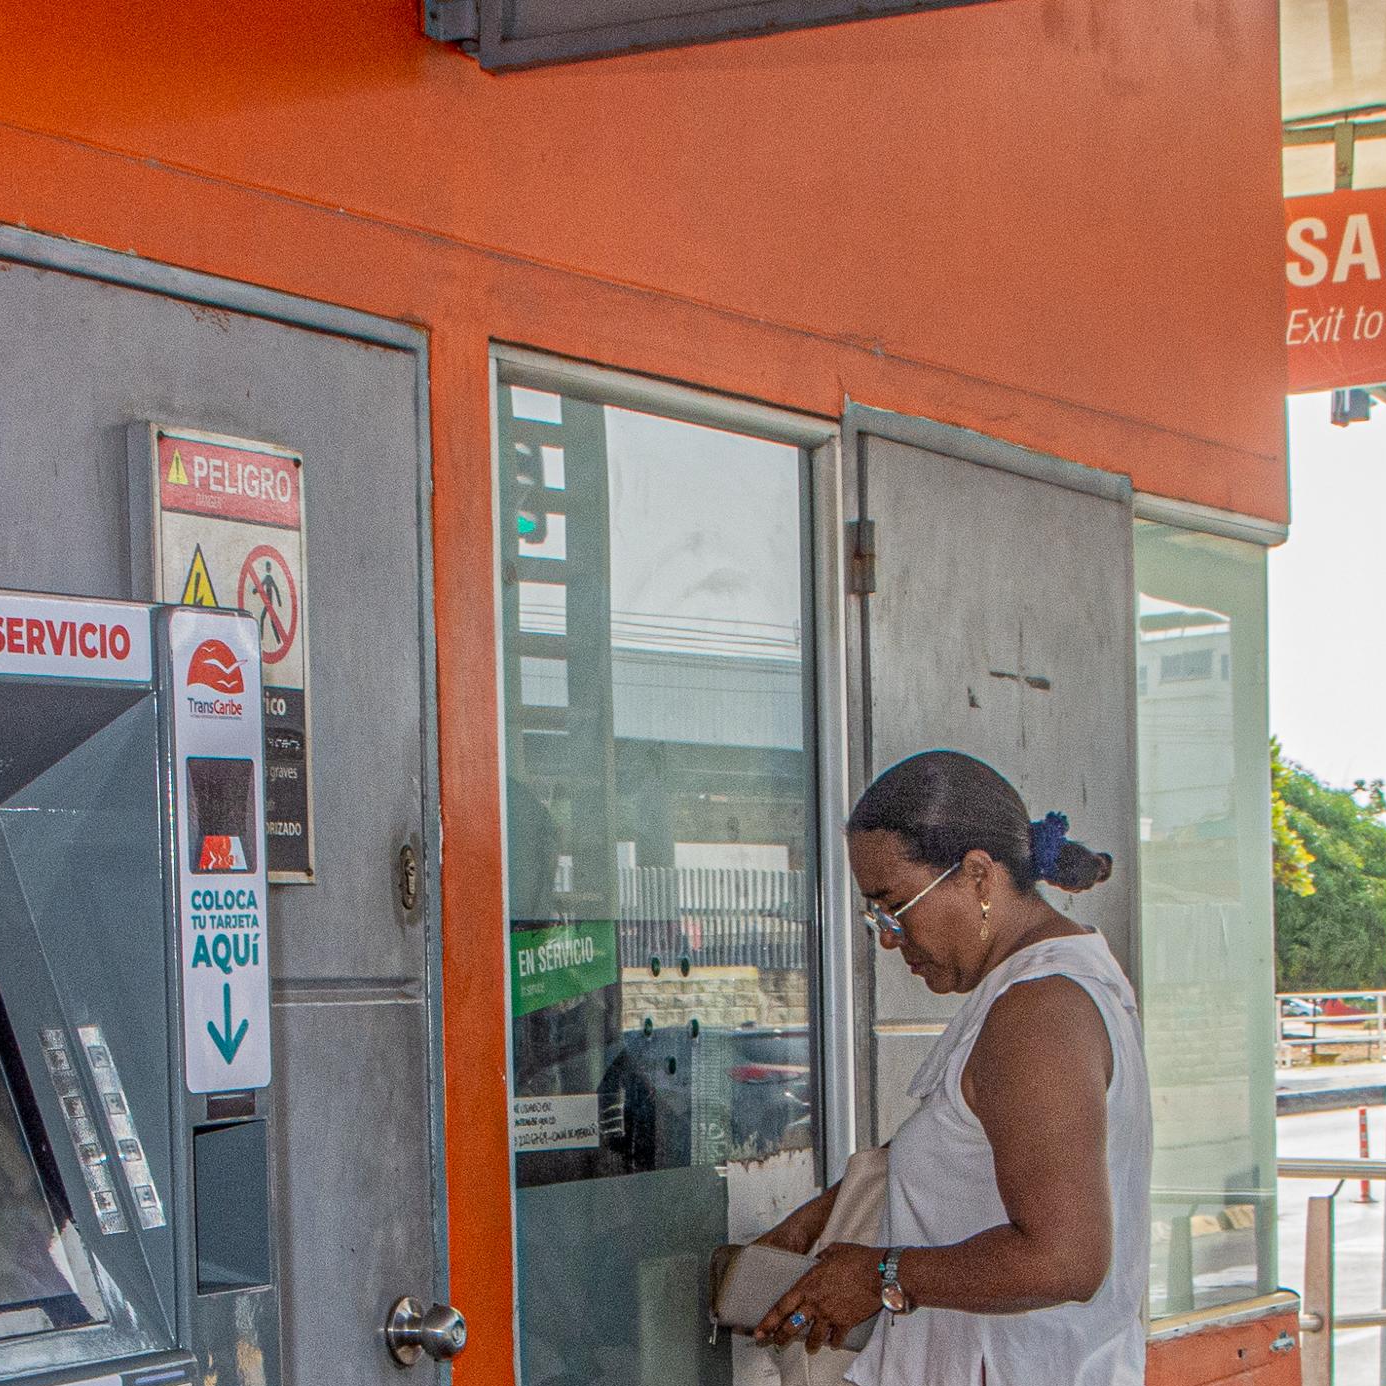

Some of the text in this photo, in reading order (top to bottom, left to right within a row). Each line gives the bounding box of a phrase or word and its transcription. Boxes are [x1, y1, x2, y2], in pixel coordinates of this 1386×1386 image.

[1285, 306, 1341, 345] Exit
[1352, 305, 1383, 341] to
[193, 455, 292, 503] PELIGRO
[187, 697, 243, 716] TransCaribe
[269, 766, 298, 782] graves
[191, 889, 258, 912] COLOCA
[191, 914, 259, 930] TU TARJETA
[518, 936, 594, 977] EN SERVICIO
